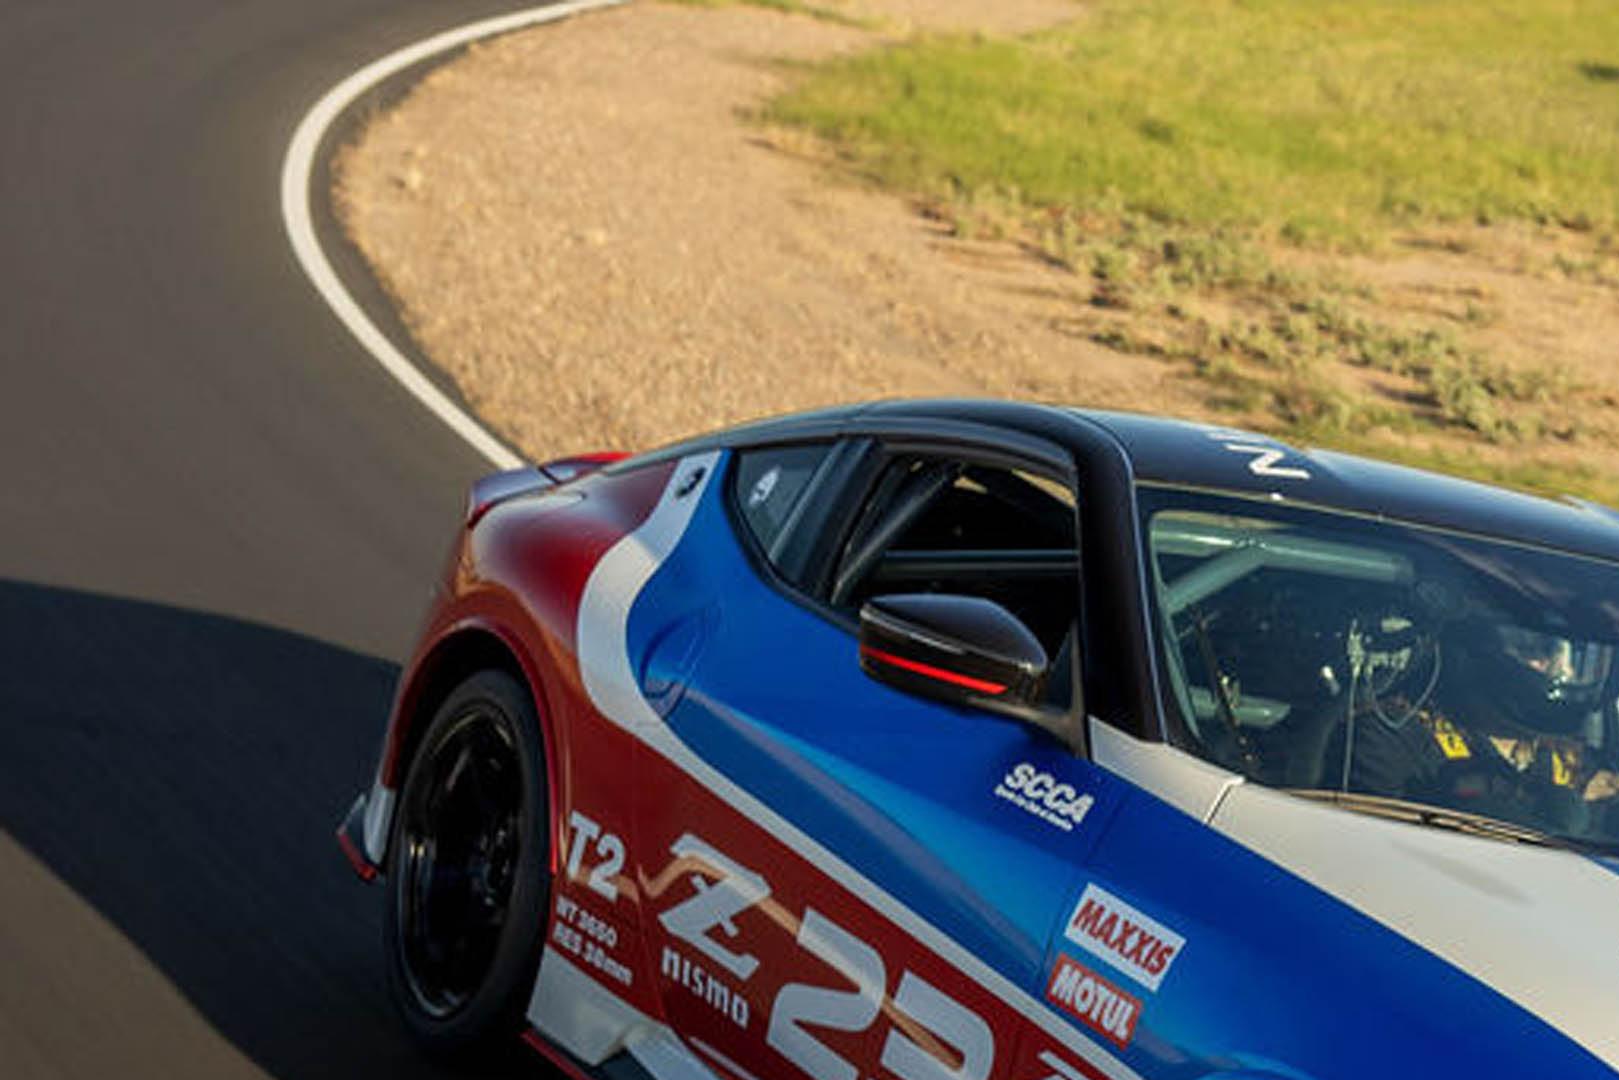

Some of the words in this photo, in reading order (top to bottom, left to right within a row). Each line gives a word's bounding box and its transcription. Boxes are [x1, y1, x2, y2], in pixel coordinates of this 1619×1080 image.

[1004, 762, 1094, 823] SCCA
[567, 809, 625, 902] T2
[1071, 898, 1175, 977] MAXXIS
[1051, 963, 1136, 1040] MOTUL
